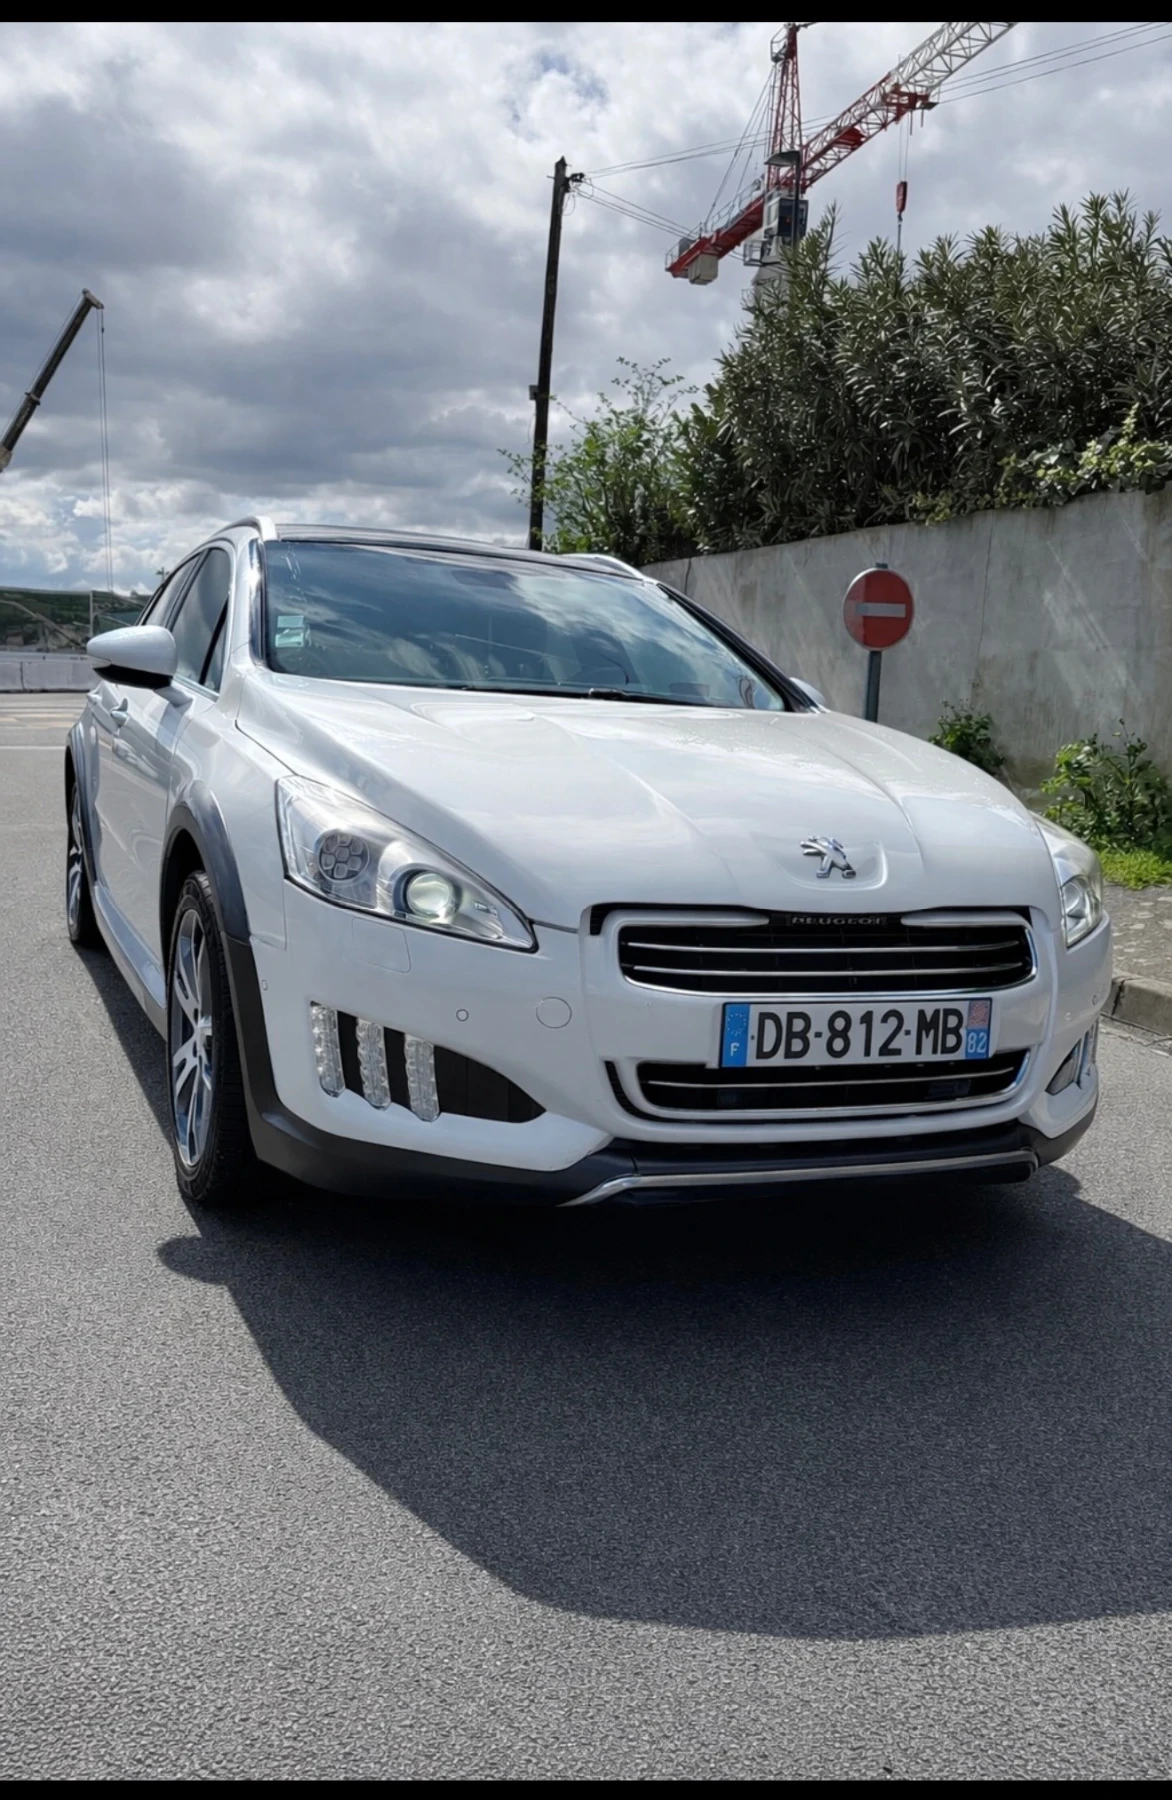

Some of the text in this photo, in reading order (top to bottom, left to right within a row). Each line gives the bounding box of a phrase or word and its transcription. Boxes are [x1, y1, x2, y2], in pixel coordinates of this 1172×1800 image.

[755, 1008, 964, 1060] DB-812-MB
[967, 1031, 987, 1054] 82
[730, 1042, 740, 1057] F
